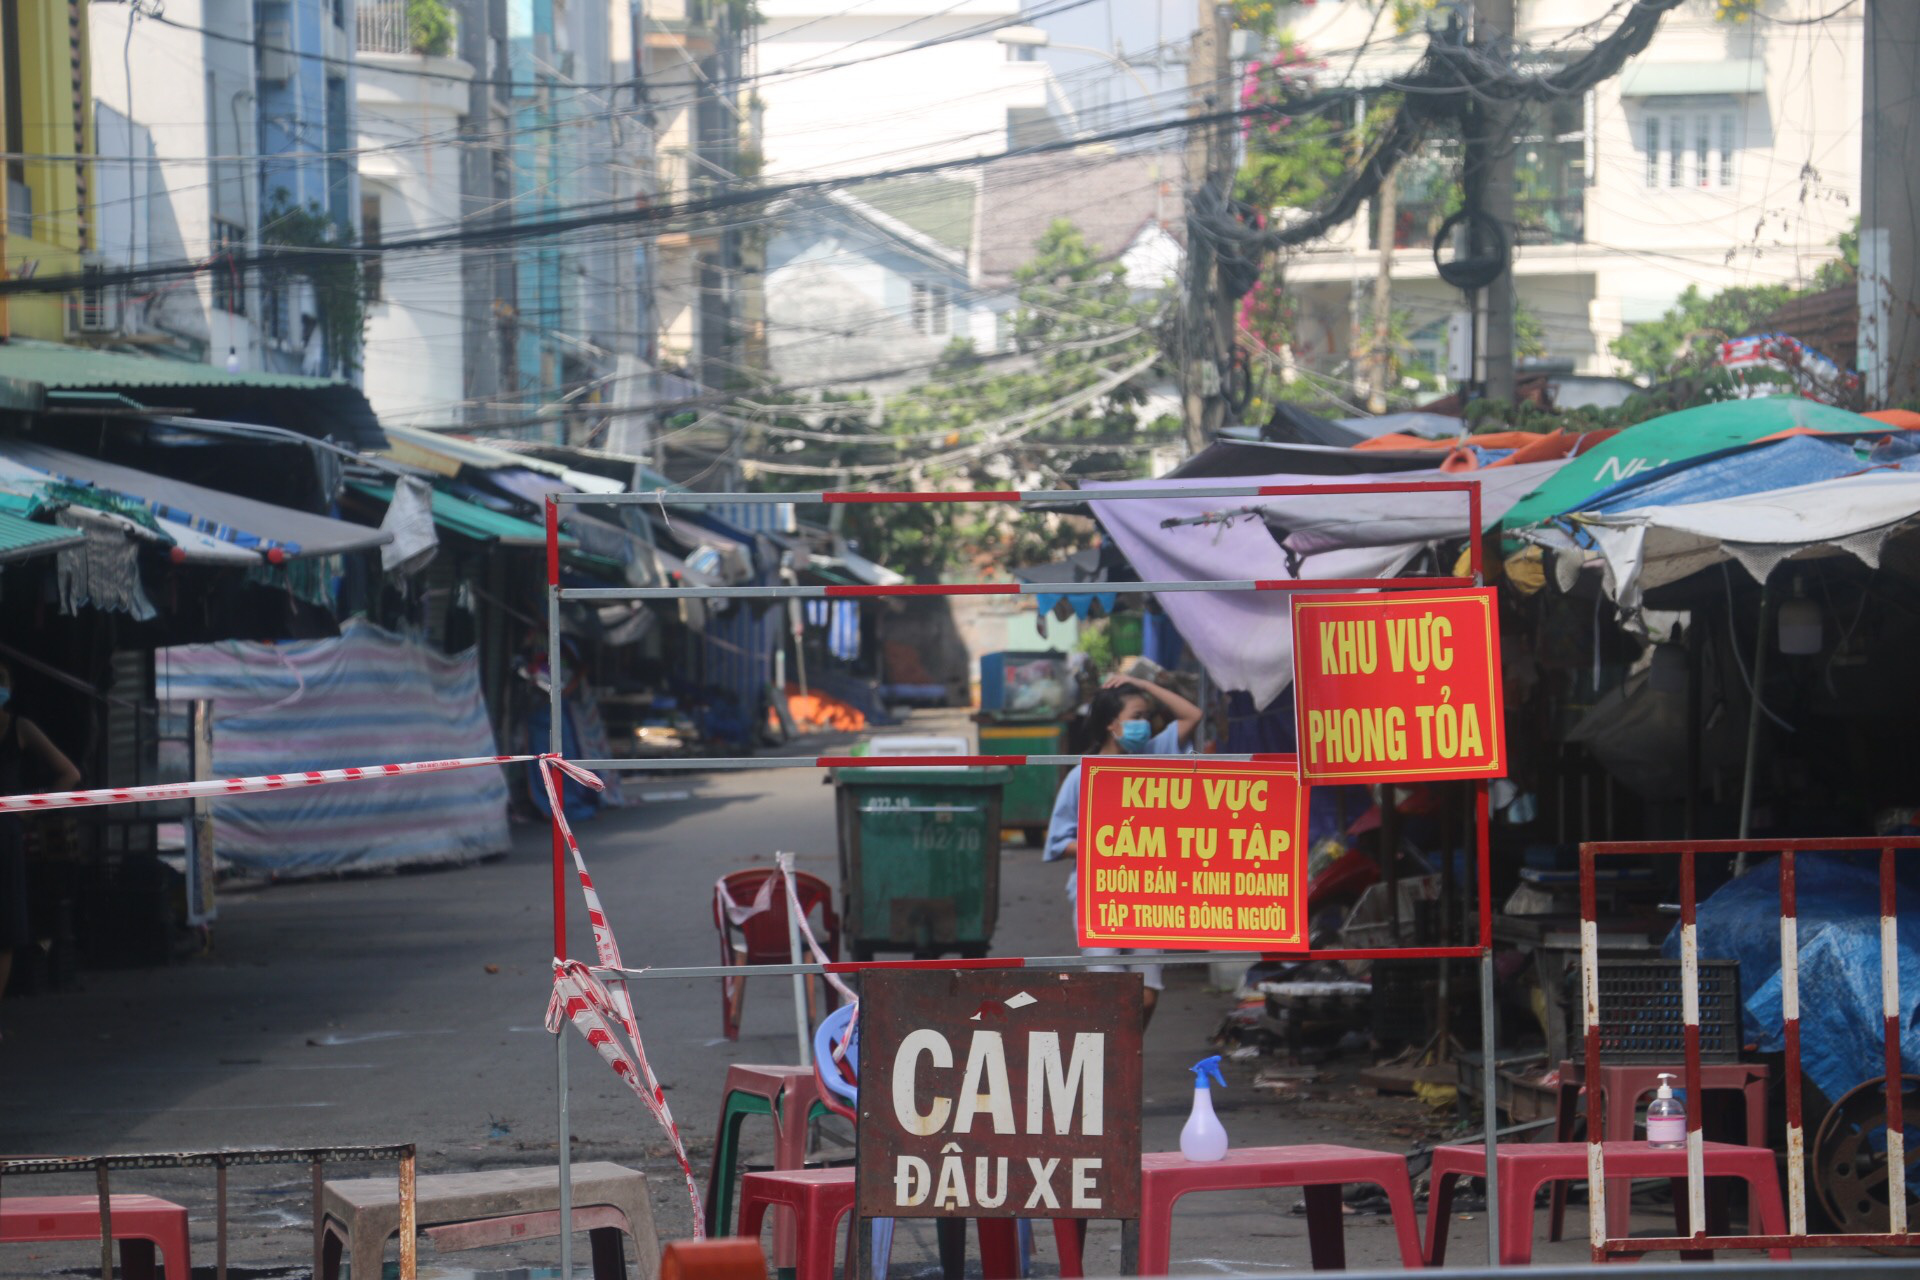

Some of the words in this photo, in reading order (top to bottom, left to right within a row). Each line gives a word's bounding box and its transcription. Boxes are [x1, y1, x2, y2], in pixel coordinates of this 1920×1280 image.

[1320, 620, 1378, 675] KHU
[1385, 611, 1454, 684] VỰC
[1308, 706, 1408, 764] PHONG
[1415, 685, 1484, 759] TỎA
[1121, 777, 1192, 809] KHU
[1203, 779, 1268, 819] VỰC
[1095, 815, 1167, 858] CẤM
[1177, 827, 1218, 868] TỤ
[1228, 823, 1291, 869] TẬP
[1096, 865, 1140, 893] BUÔN
[1144, 865, 1177, 894] BÁN
[1192, 871, 1230, 895] KINH
[1235, 872, 1289, 897] DOANH
[1098, 899, 1129, 932] TẬP
[1133, 904, 1185, 928] TRUNG
[1189, 901, 1233, 930] ĐÔNG
[1237, 902, 1286, 930] NGƯỜI
[894, 1142, 1009, 1211] ĐẬU
[1024, 1158, 1102, 1209] XE
